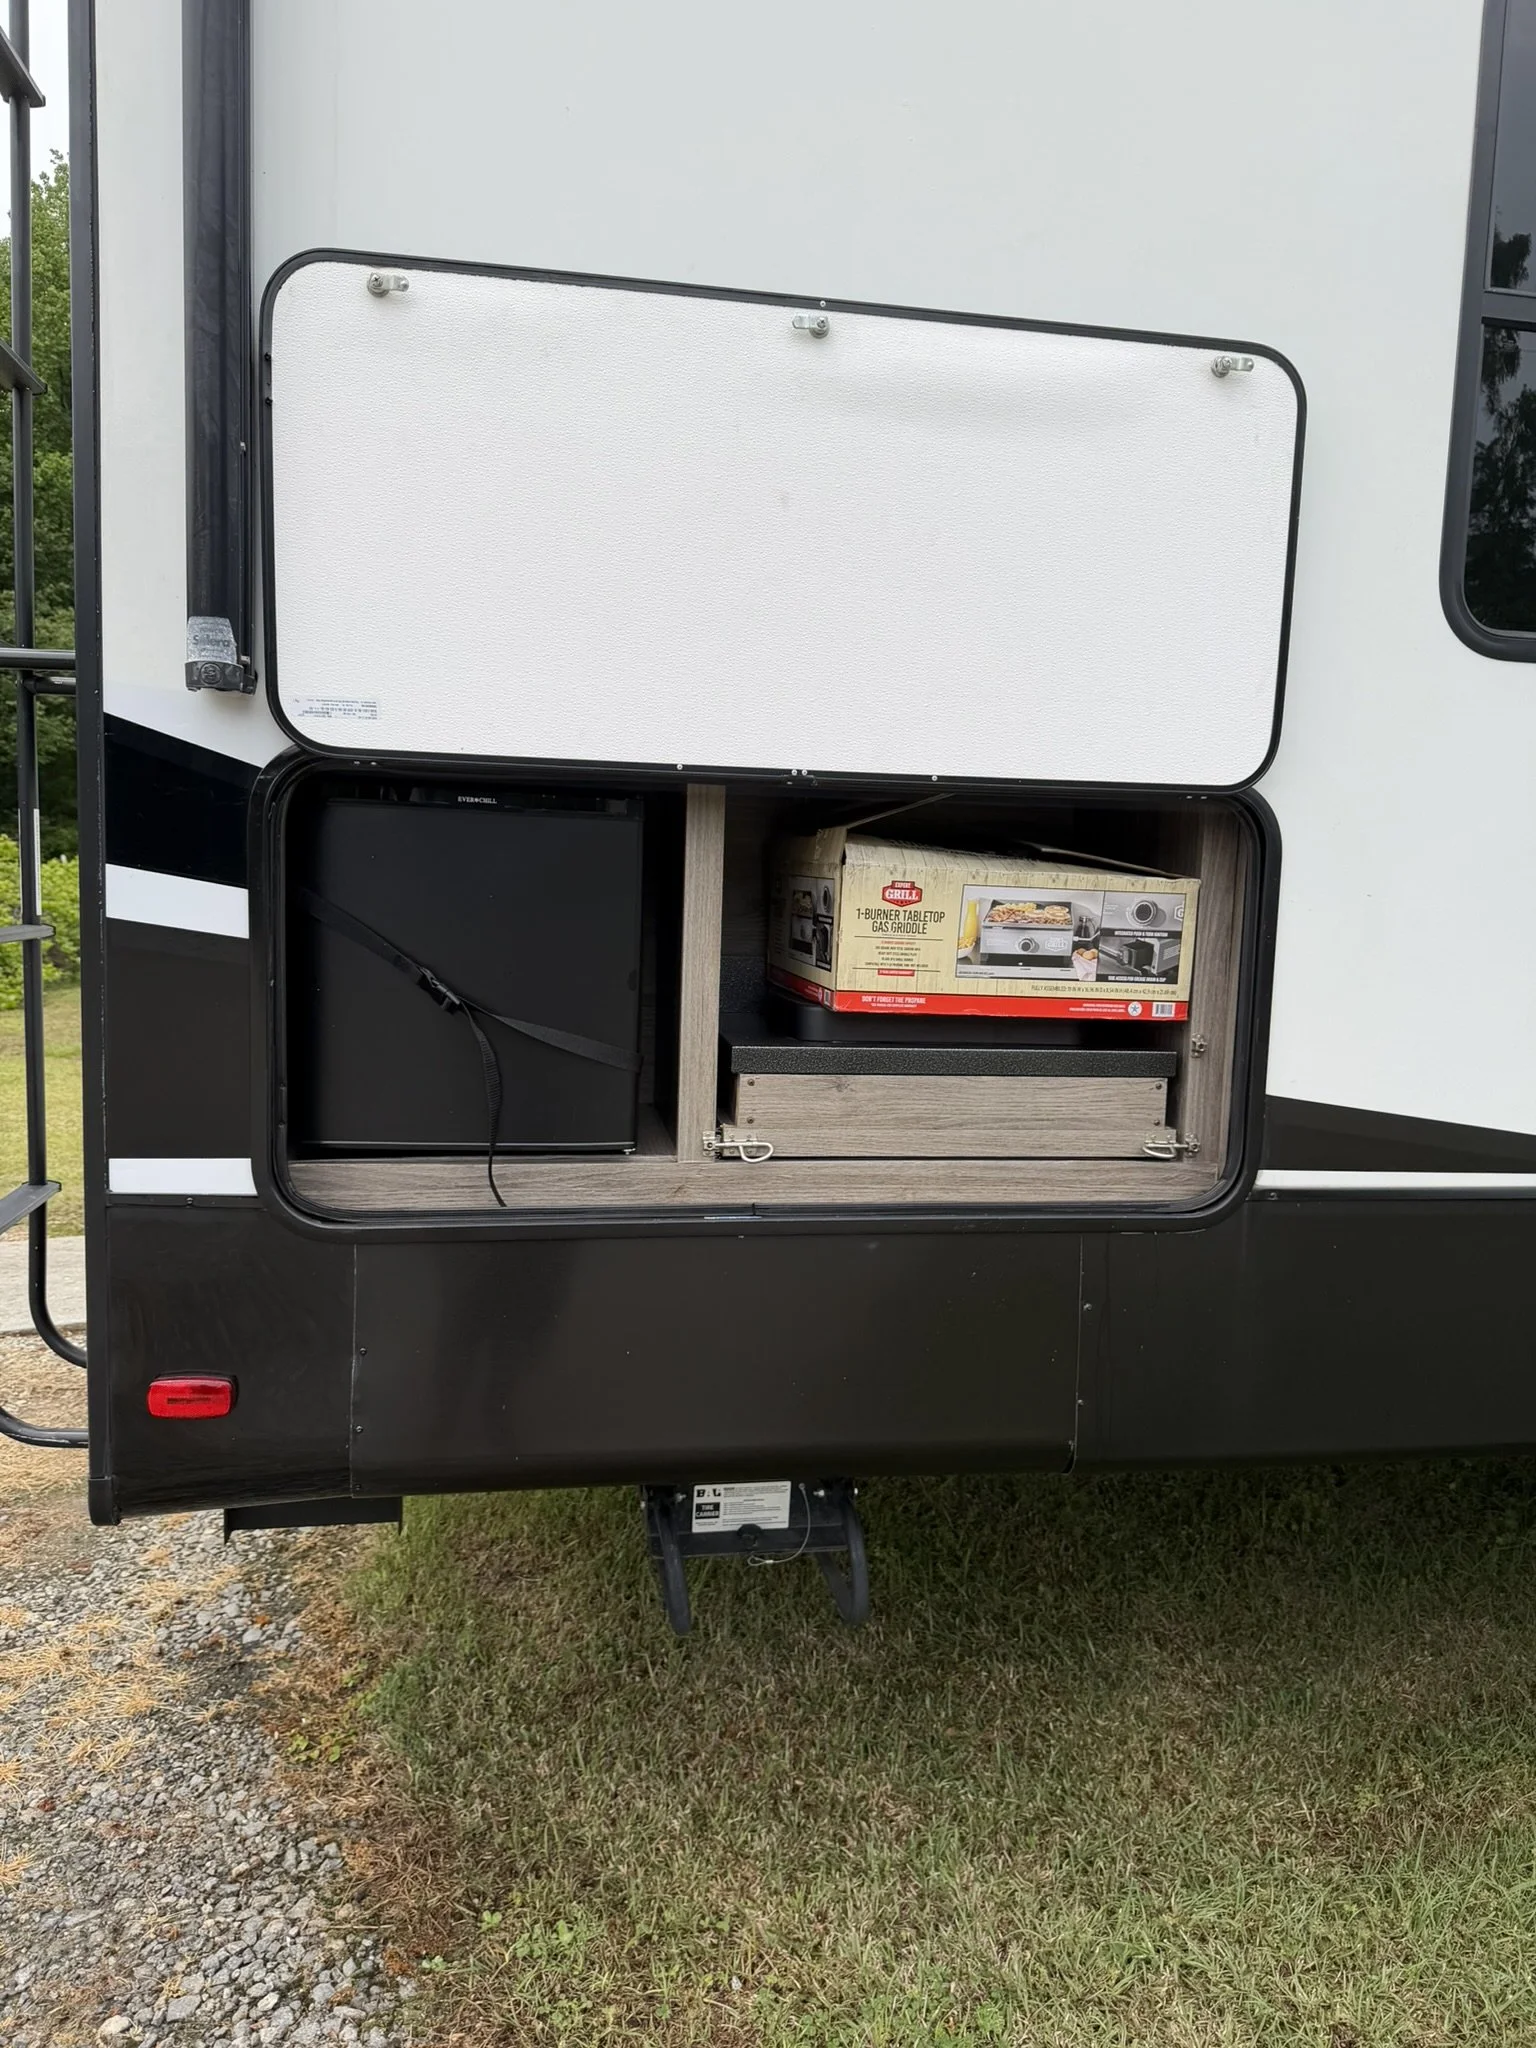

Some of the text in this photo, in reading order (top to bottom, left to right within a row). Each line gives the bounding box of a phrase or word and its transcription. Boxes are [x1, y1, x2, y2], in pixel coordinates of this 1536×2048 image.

[885, 888, 919, 900] GRILL
[856, 908, 946, 923] 1-BURNER TABLETOP
[871, 920, 928, 935] GAS GRIDDLE
[696, 1488, 721, 1497] BL
